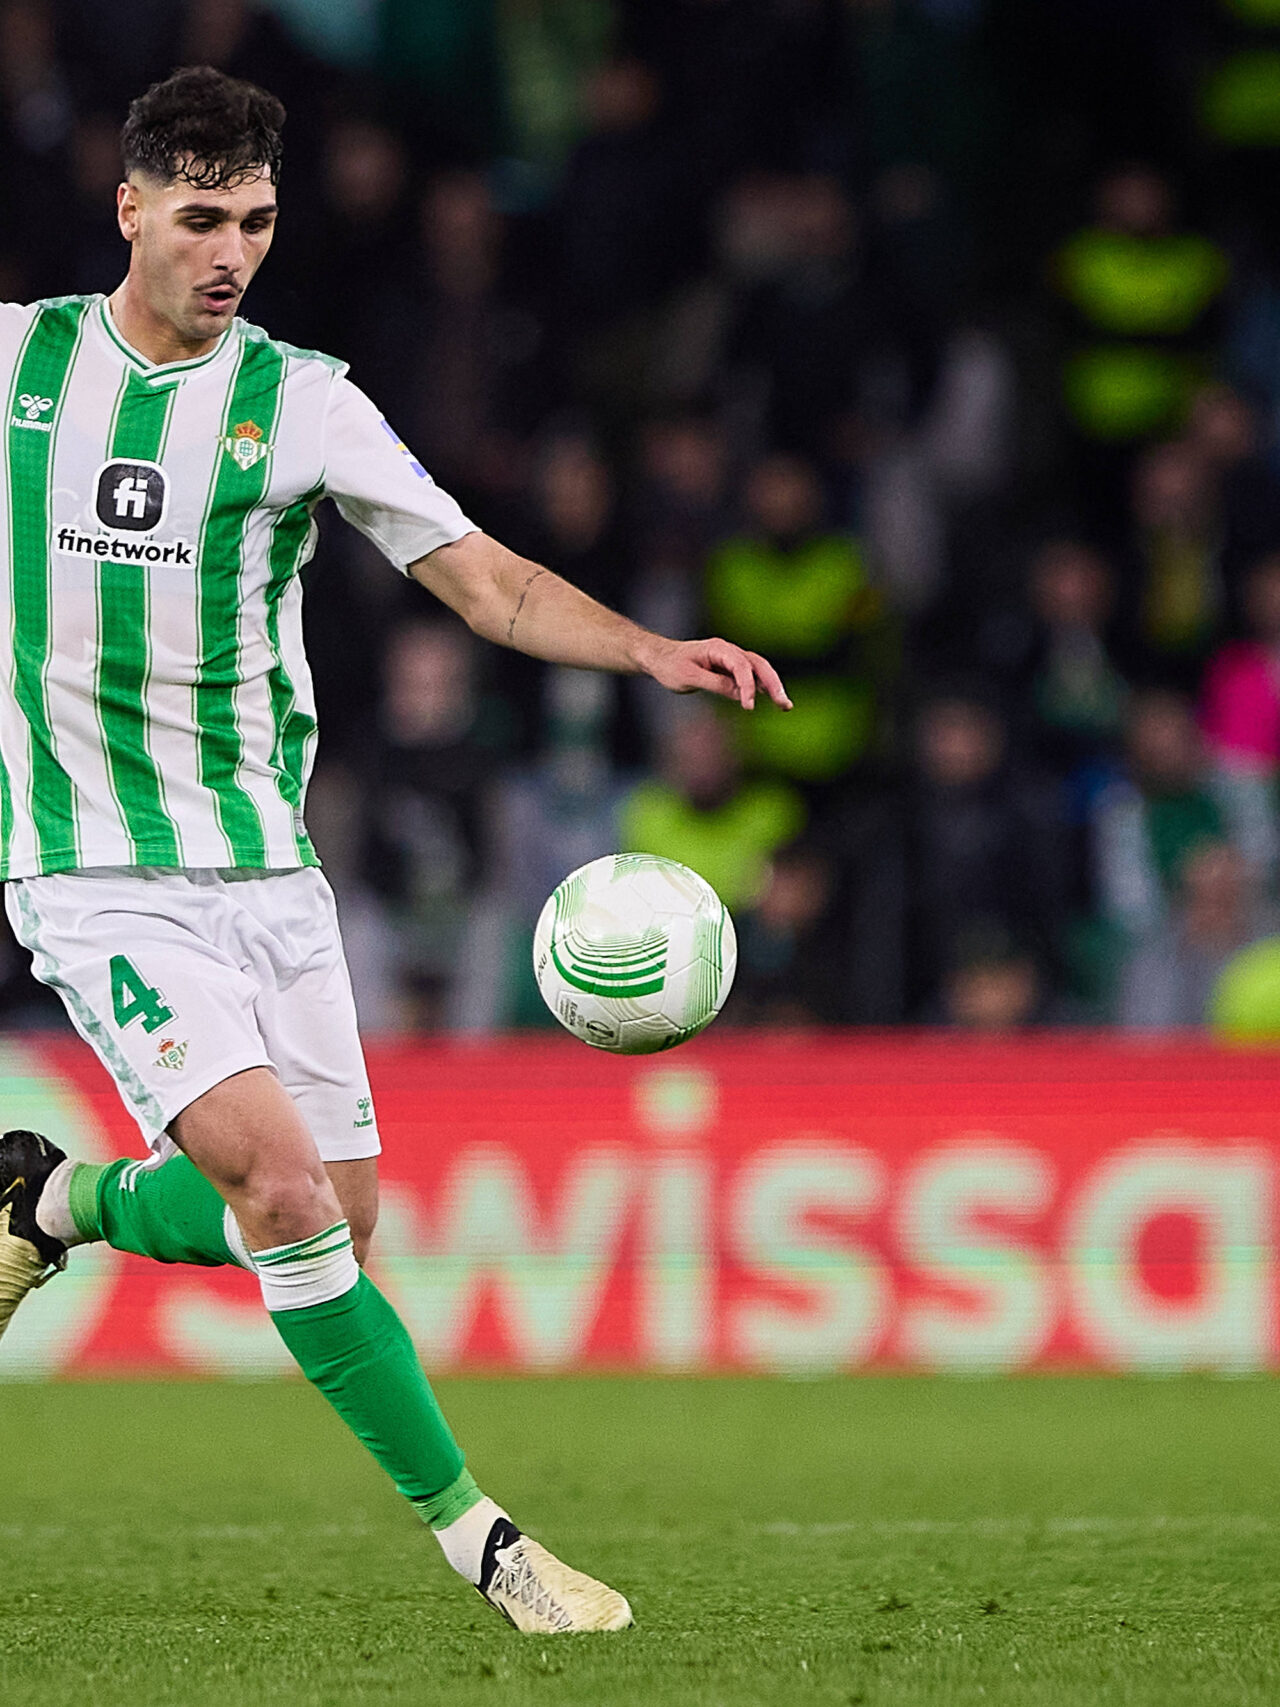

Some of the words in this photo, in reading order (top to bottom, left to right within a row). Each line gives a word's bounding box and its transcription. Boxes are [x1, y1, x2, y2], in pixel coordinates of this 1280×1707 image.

[113, 477, 148, 519] fi
[57, 527, 193, 565] finetwork
[109, 954, 178, 1034] 4
